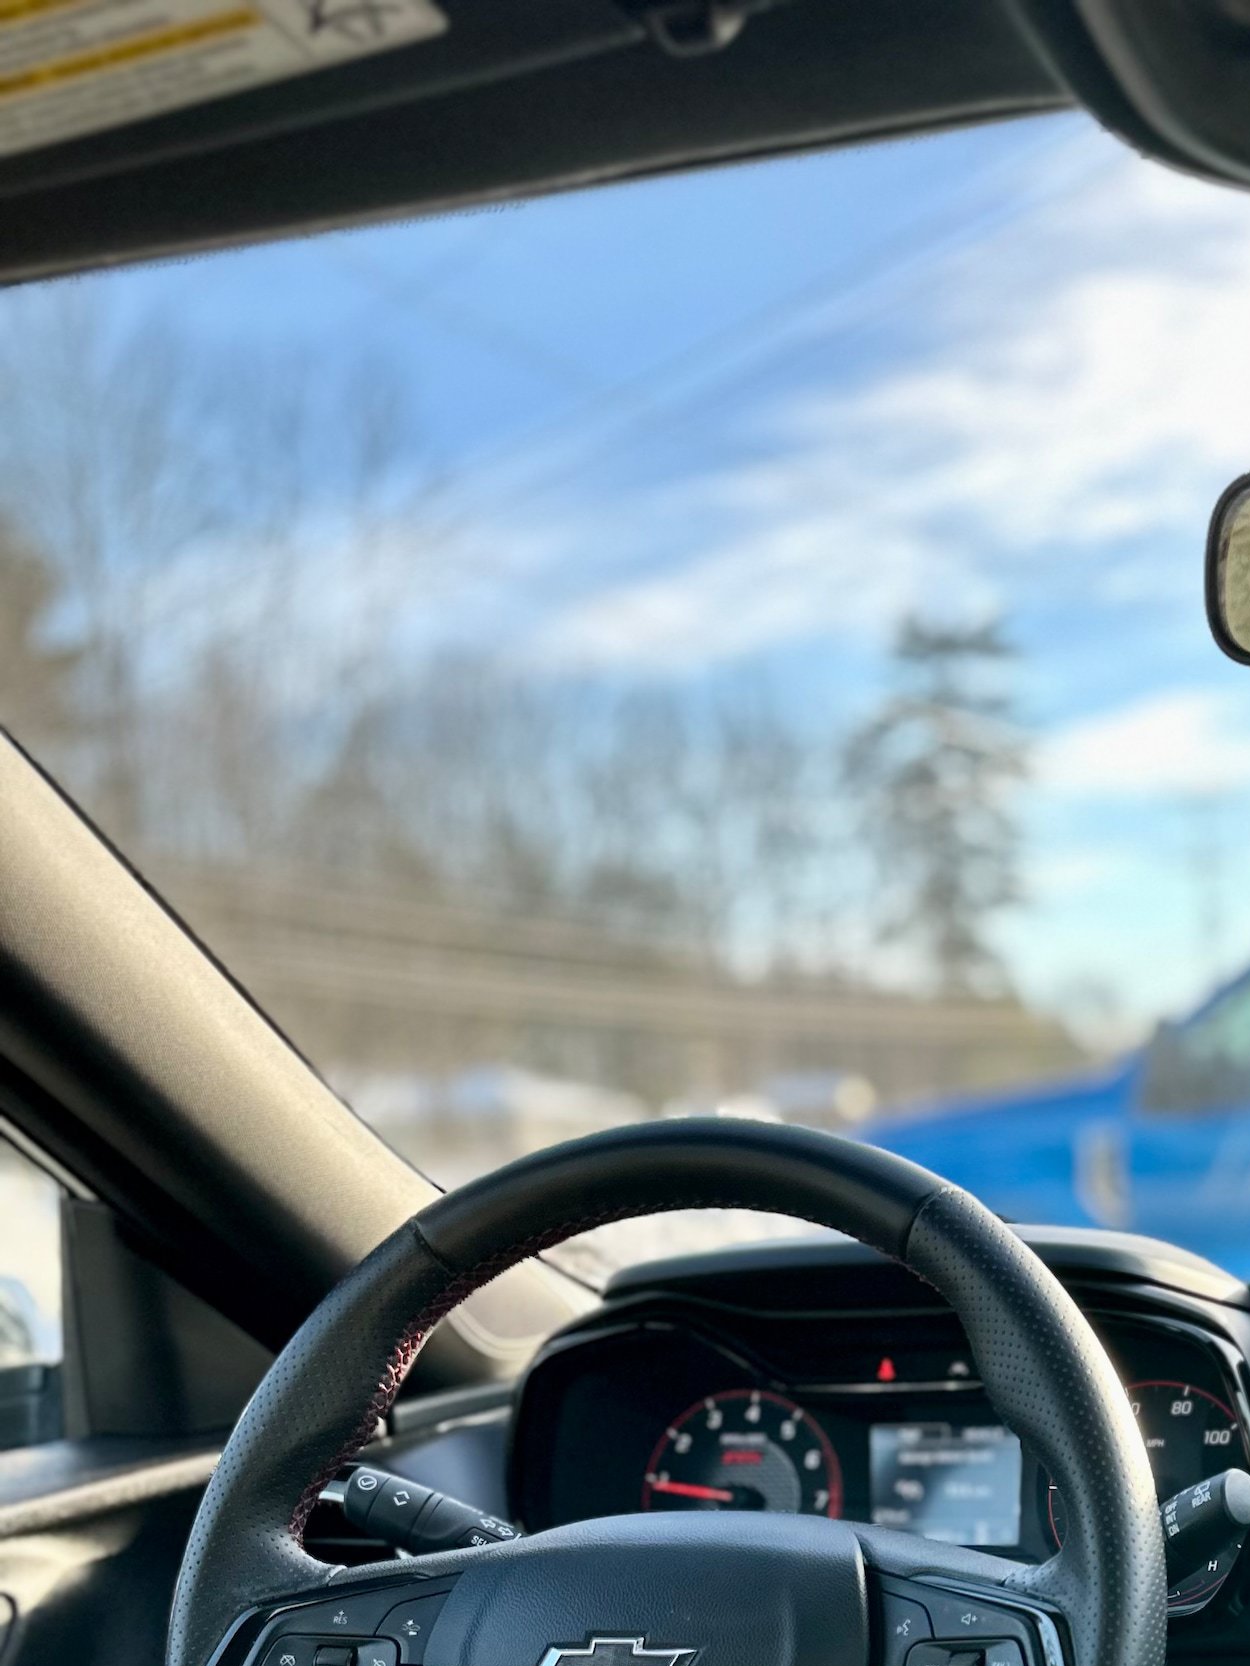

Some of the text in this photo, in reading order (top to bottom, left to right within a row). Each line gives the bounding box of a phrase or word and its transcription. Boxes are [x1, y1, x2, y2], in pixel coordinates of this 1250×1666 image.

[1170, 1400, 1193, 1415] 80
[1145, 1439, 1165, 1448] MPH
[1203, 1430, 1231, 1445] 100
[1191, 1491, 1212, 1508] REAR
[1165, 1501, 1178, 1514] OFF
[1165, 1511, 1178, 1525] INT
[1168, 1523, 1180, 1537] ON
[1207, 1560, 1218, 1572] H
[333, 1616, 348, 1625] RES
